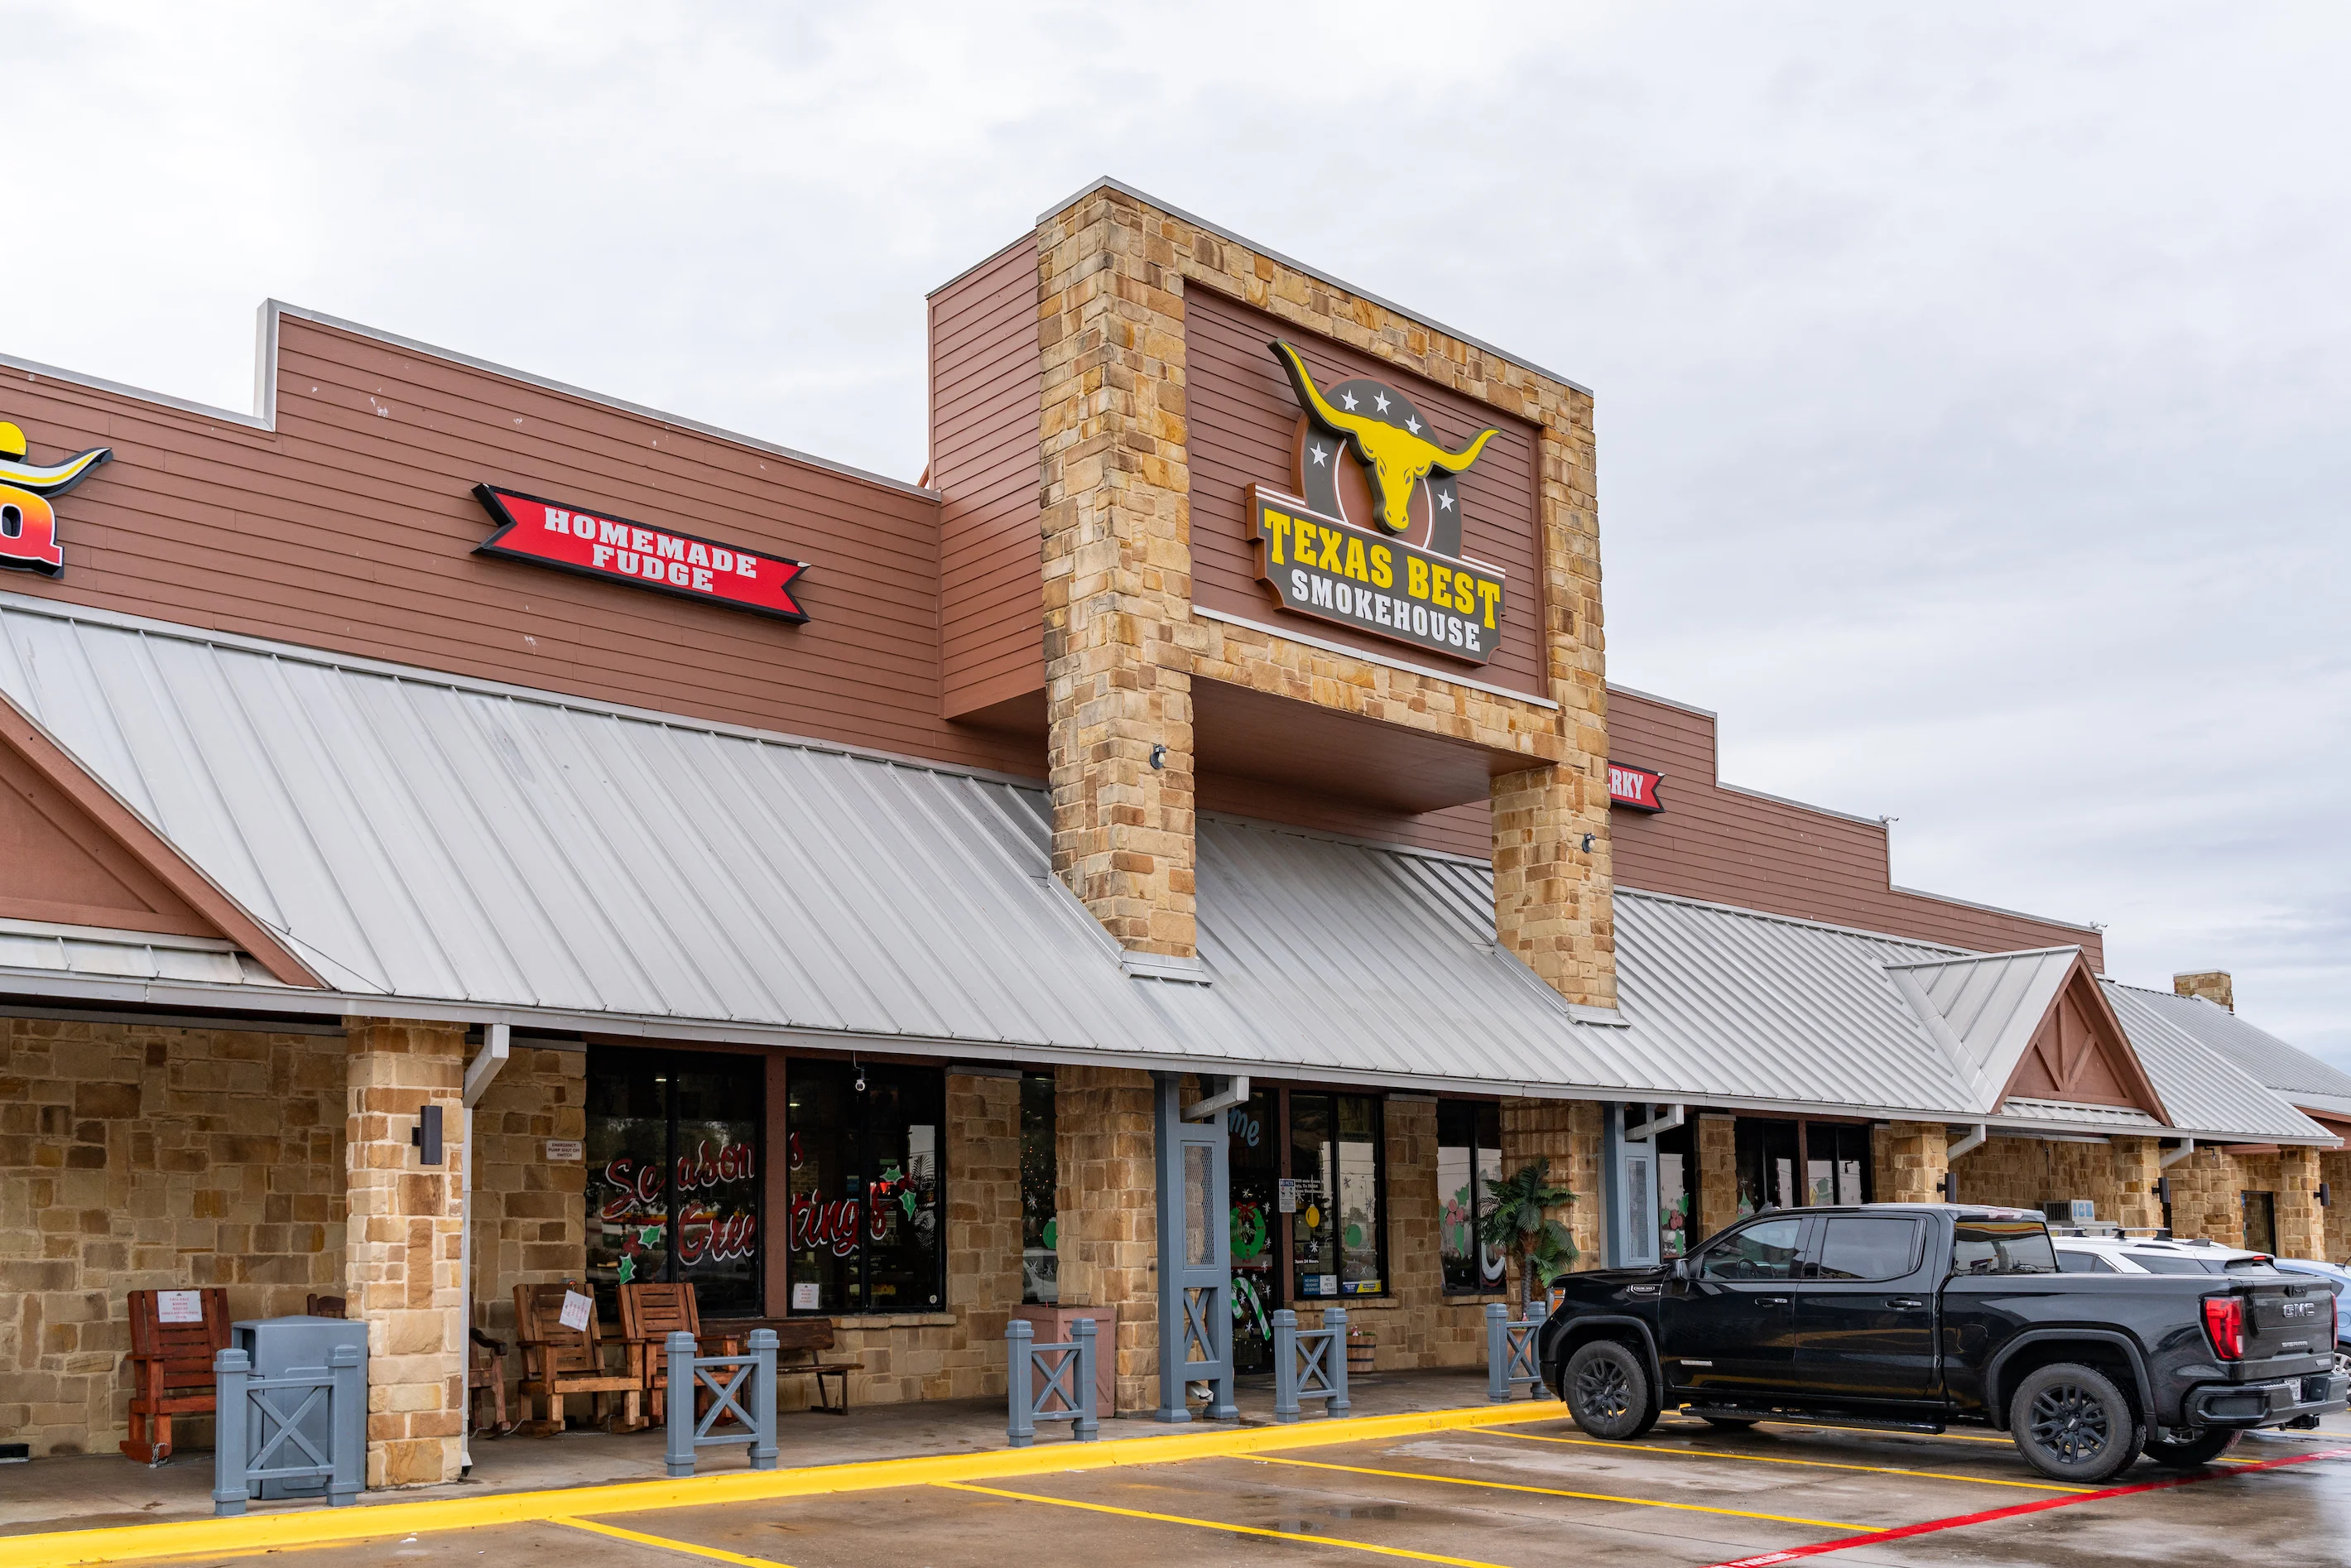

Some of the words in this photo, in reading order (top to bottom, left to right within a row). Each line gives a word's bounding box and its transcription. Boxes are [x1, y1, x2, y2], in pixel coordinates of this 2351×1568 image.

[544, 507, 757, 579] HOMEMADE
[593, 544, 714, 592] FUDGE
[1264, 507, 1393, 589] TEXAS
[1406, 555, 1500, 630] BEST
[1291, 568, 1481, 652] SMOKEHOUSE
[1608, 767, 1644, 801] RKY
[1228, 1107, 1259, 1147] me
[2073, 1203, 2094, 1217] ICE
[2283, 1303, 2315, 1318] GMC
